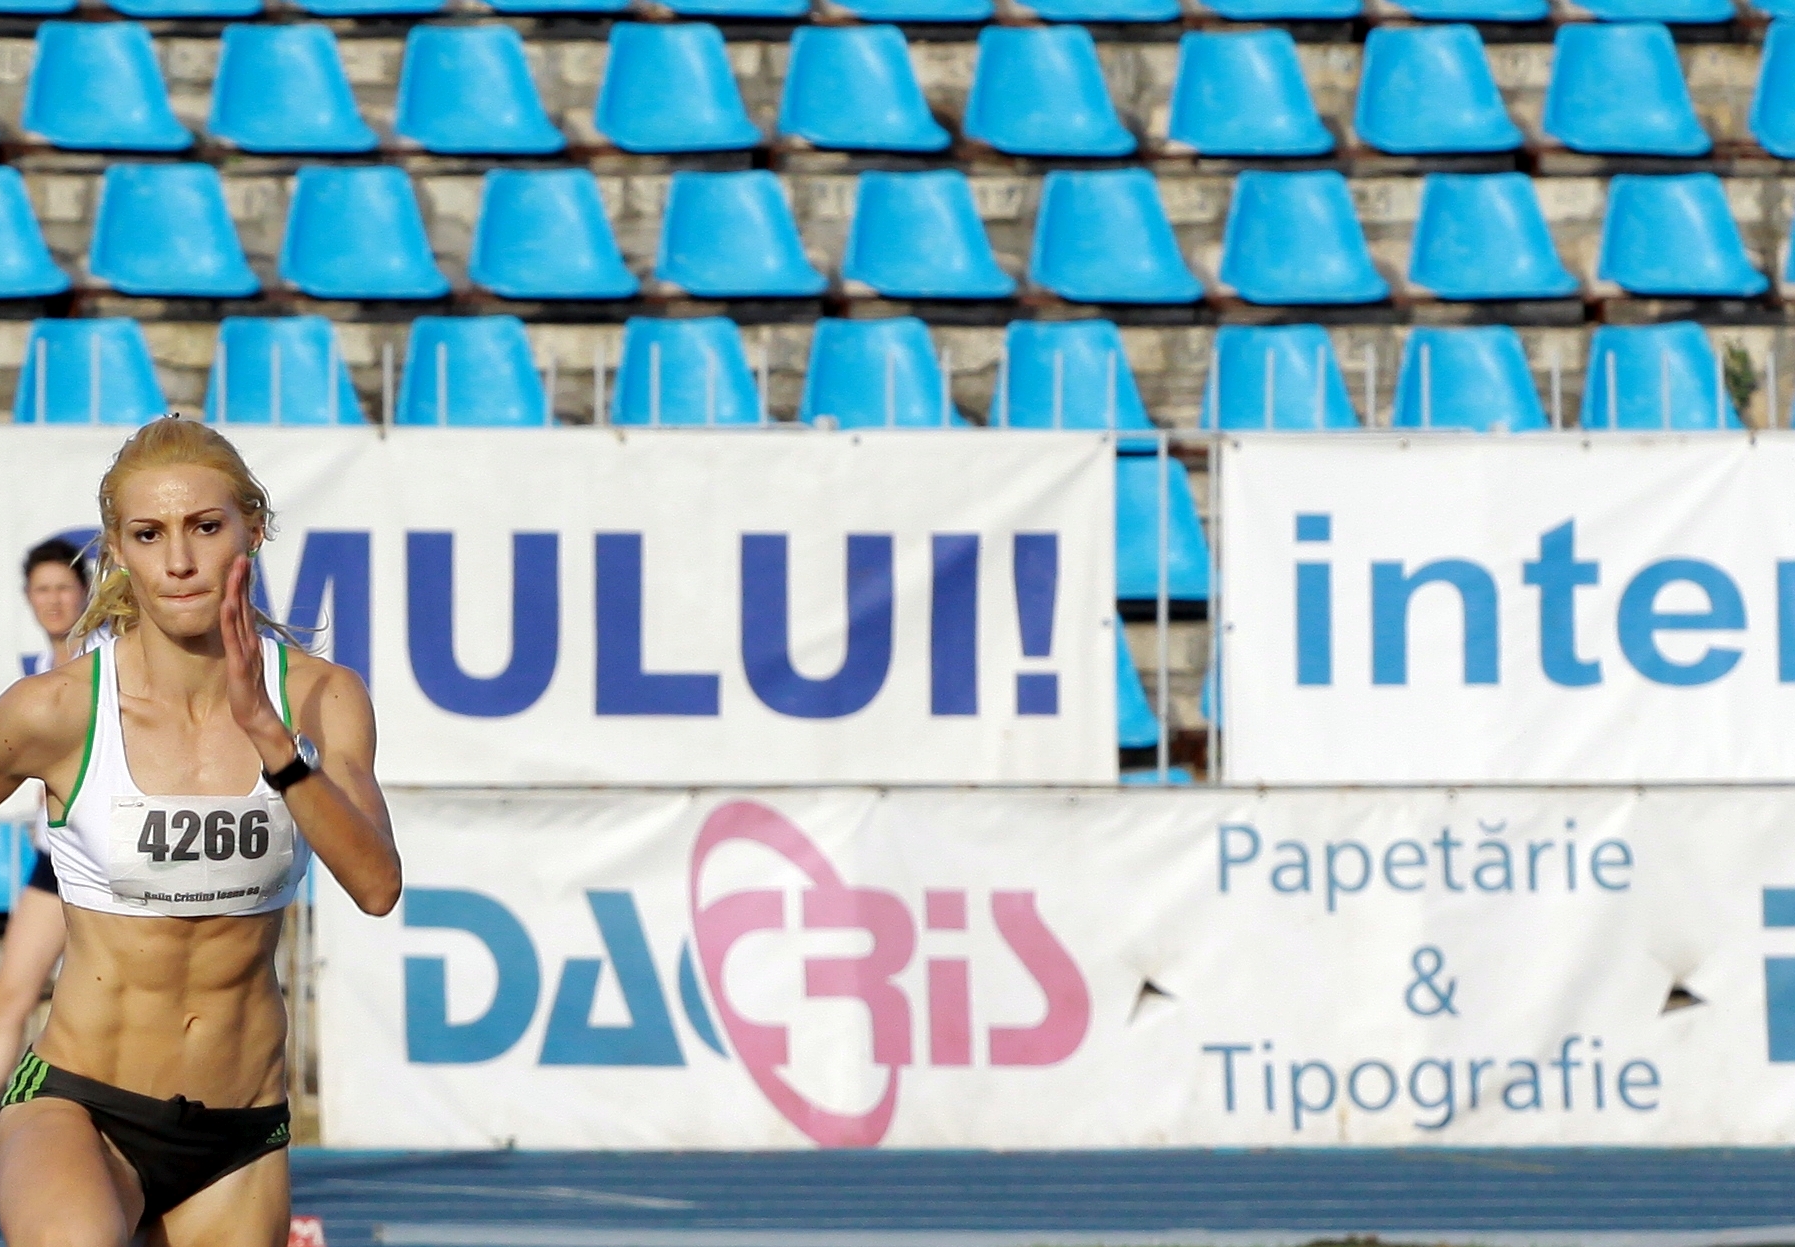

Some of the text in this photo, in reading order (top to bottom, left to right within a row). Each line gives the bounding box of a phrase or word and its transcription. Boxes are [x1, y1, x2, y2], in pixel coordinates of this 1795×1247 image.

[1294, 512, 1795, 689] inte
[137, 809, 270, 862] 4266
[1216, 818, 1634, 914] Papetărie
[1404, 944, 1460, 1018] &
[1201, 1035, 1663, 1132] Tipografie
